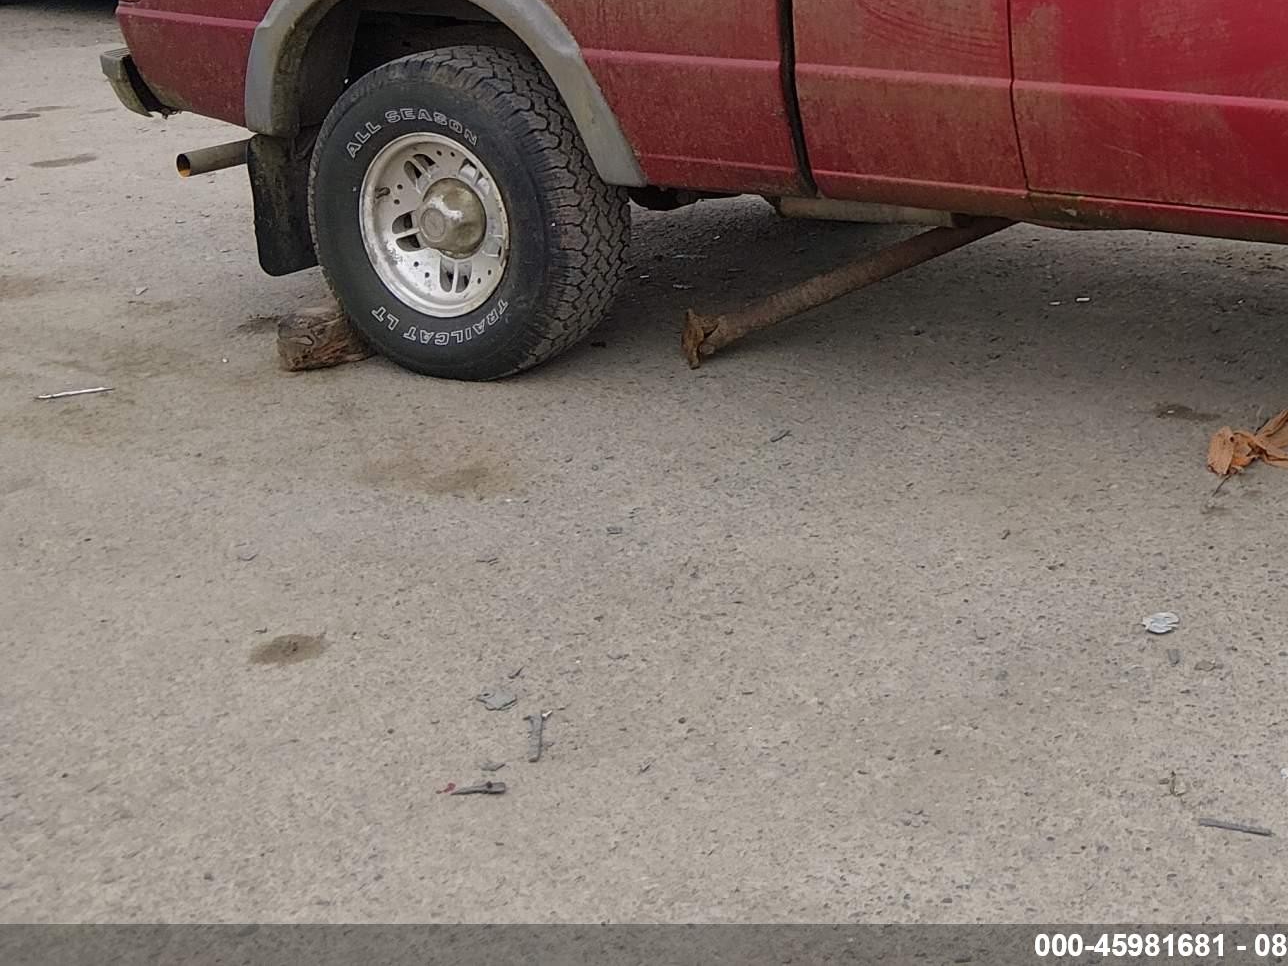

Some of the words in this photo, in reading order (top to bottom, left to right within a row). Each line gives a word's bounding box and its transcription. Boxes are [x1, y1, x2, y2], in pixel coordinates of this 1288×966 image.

[346, 121, 382, 159] ALL
[384, 107, 479, 147] SEASON
[371, 306, 400, 331] LT
[403, 299, 510, 346] TRAILCAT
